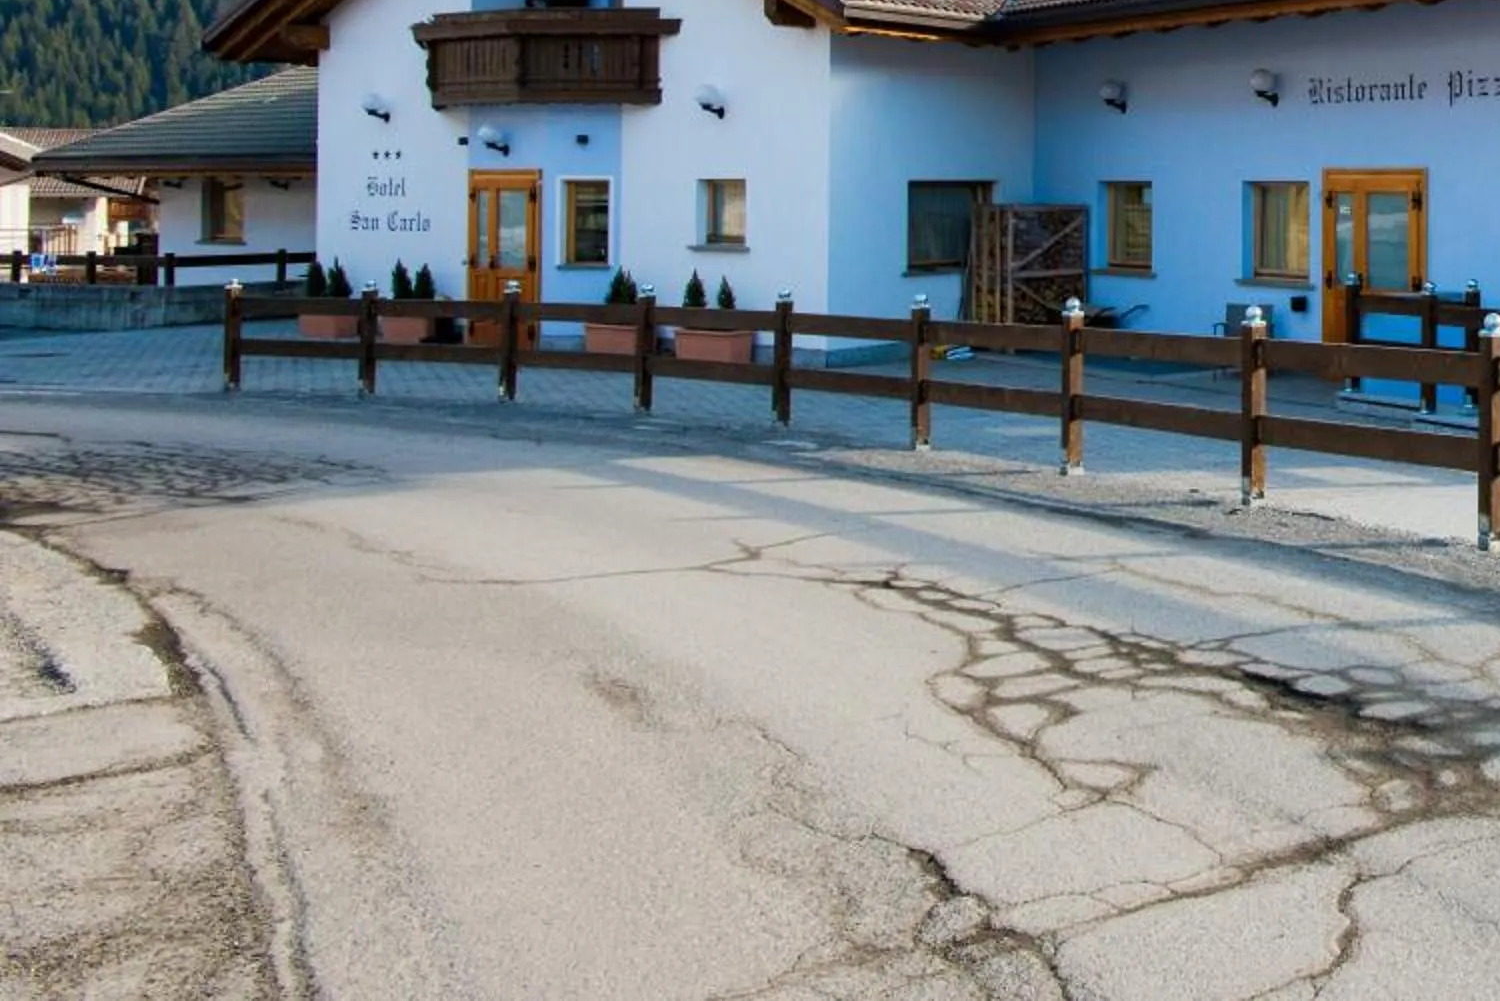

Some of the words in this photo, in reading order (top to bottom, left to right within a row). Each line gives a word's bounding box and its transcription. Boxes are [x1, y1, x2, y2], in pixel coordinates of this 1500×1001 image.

[1307, 73, 1428, 105] Ristorante
[366, 176, 406, 197] Hotel
[350, 209, 380, 231] San
[386, 210, 431, 232] Carlo
